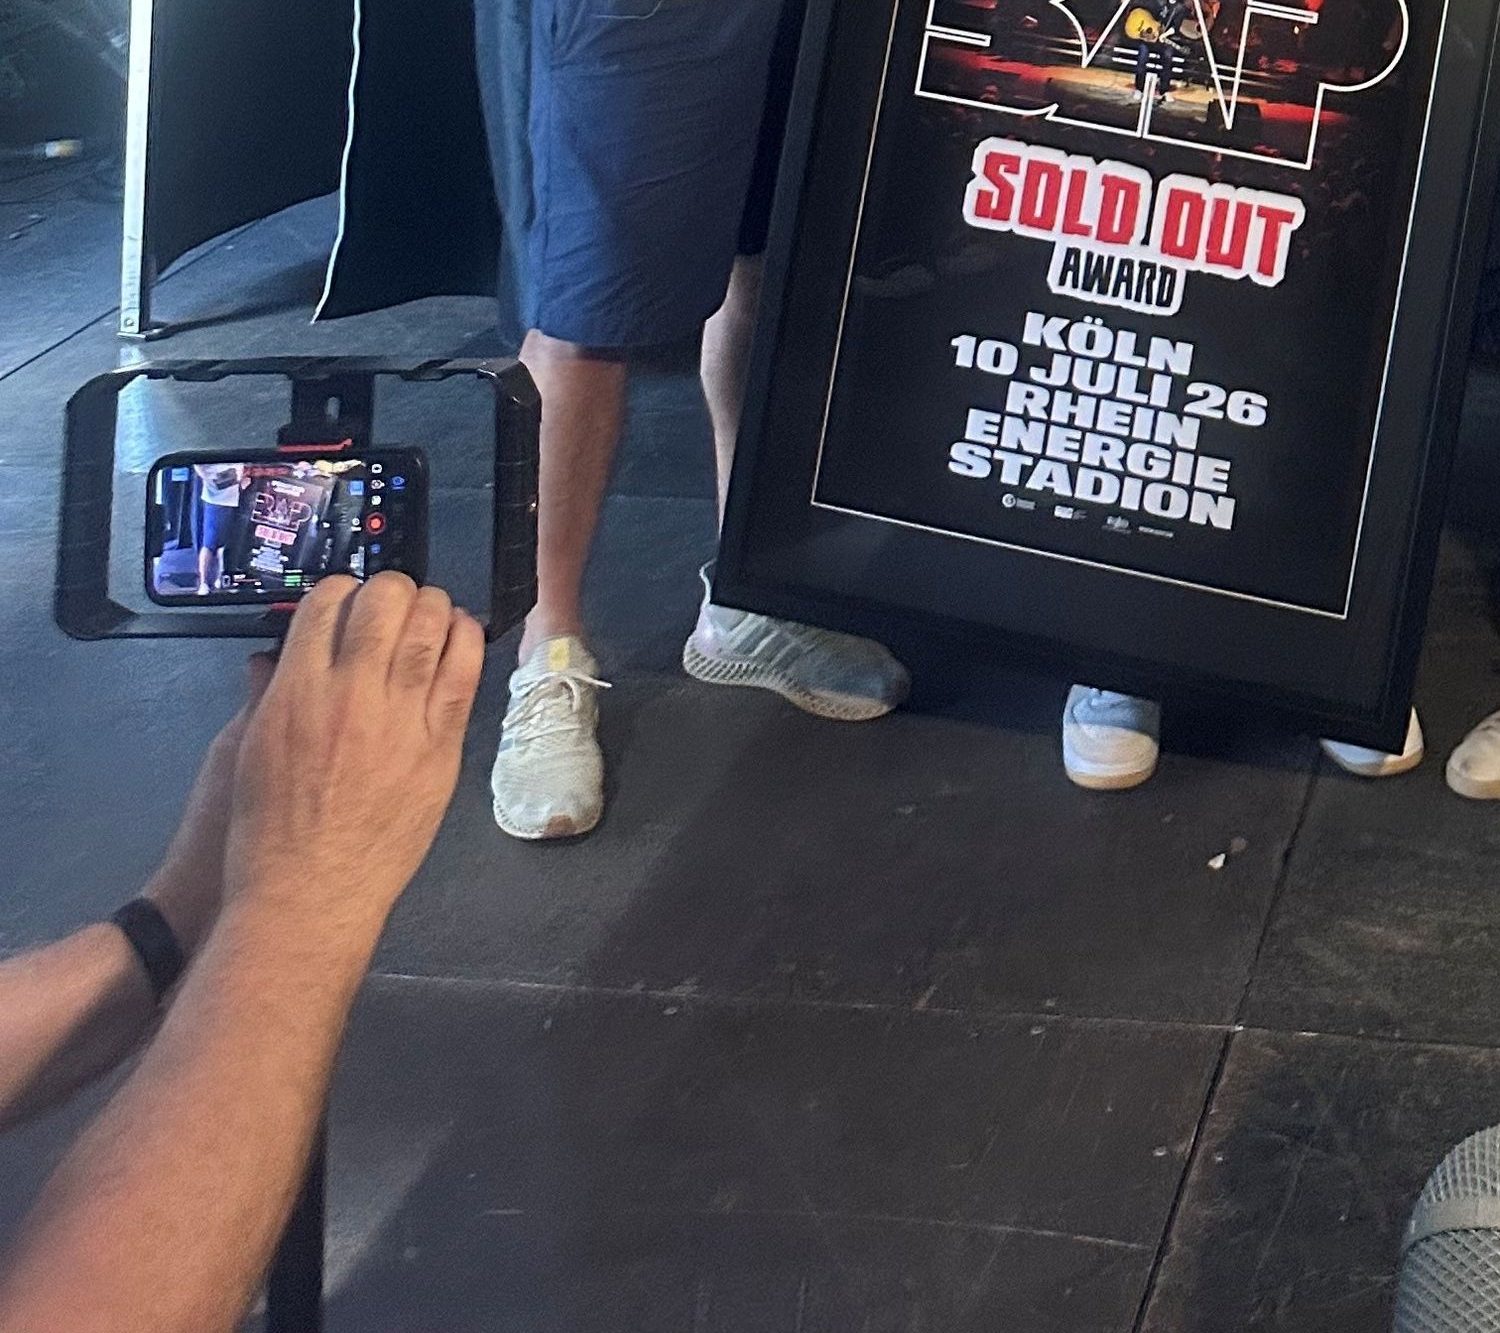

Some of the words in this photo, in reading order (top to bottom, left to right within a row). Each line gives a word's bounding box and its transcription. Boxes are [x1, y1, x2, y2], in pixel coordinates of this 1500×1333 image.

[973, 151, 1142, 246] SOLD
[1160, 188, 1297, 277] OUT
[1058, 247, 1178, 309] AWARD
[950, 334, 1020, 376] 10
[1030, 353, 1173, 408] JULI
[1183, 385, 1269, 428] 26
[1022, 312, 1194, 376] KÖLN
[964, 408, 1232, 493] ENERGIE
[1005, 381, 1201, 451] RHEIN
[948, 442, 1236, 531] STADION
